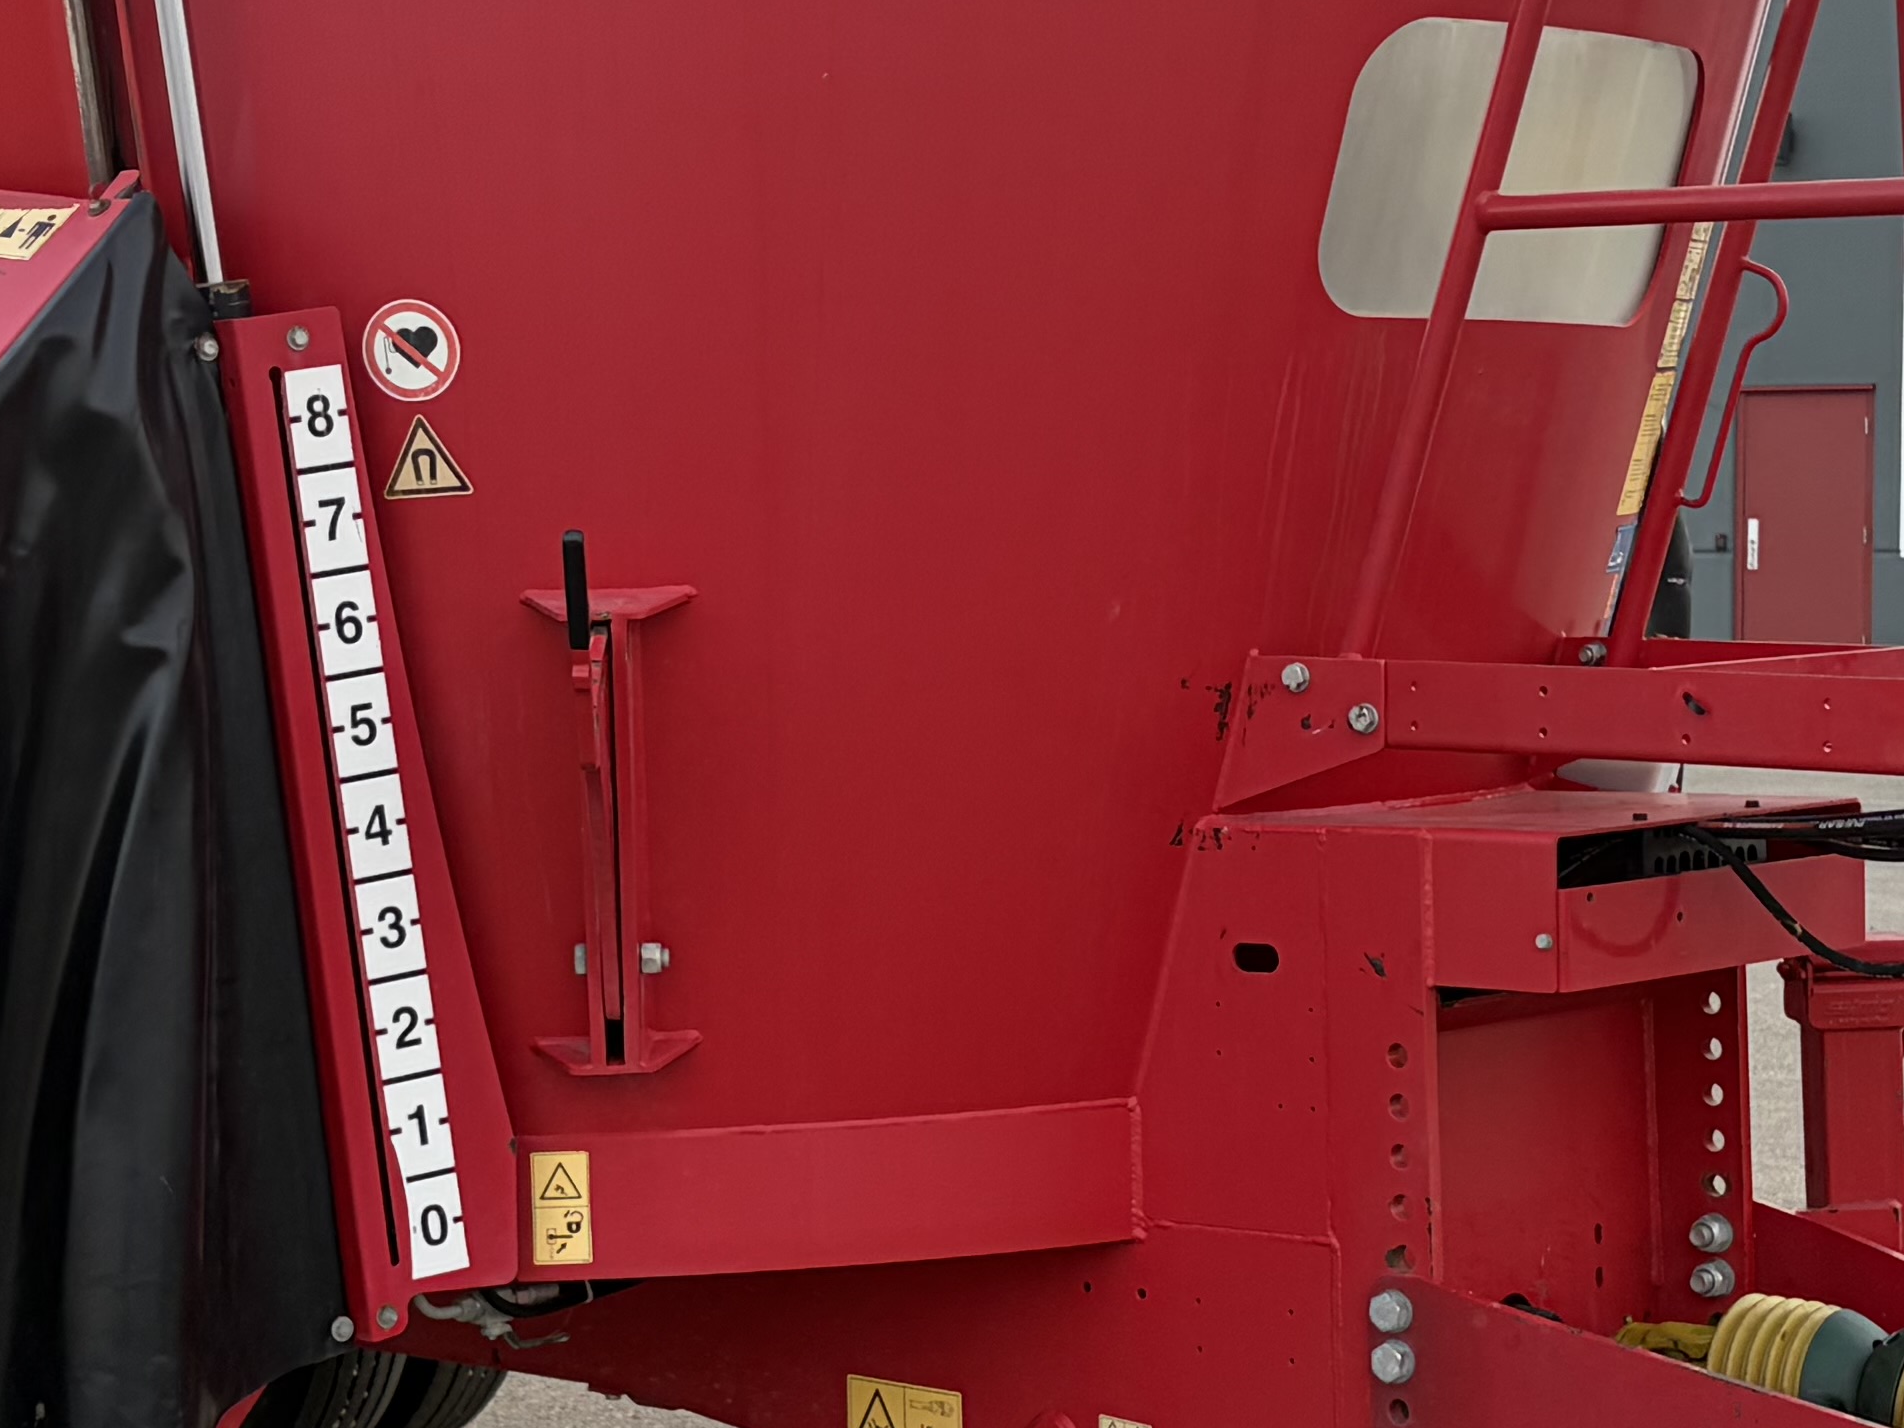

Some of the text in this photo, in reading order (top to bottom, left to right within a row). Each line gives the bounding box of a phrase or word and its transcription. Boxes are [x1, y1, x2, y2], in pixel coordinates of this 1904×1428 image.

[306, 393, 335, 438] 8
[317, 496, 346, 542] 7
[334, 600, 364, 645] 6
[349, 702, 378, 747] 5
[364, 804, 393, 847] 4
[377, 905, 407, 950] 3
[392, 1006, 422, 1050] 2
[407, 1104, 430, 1147] 1
[420, 1204, 449, 1247] 0
